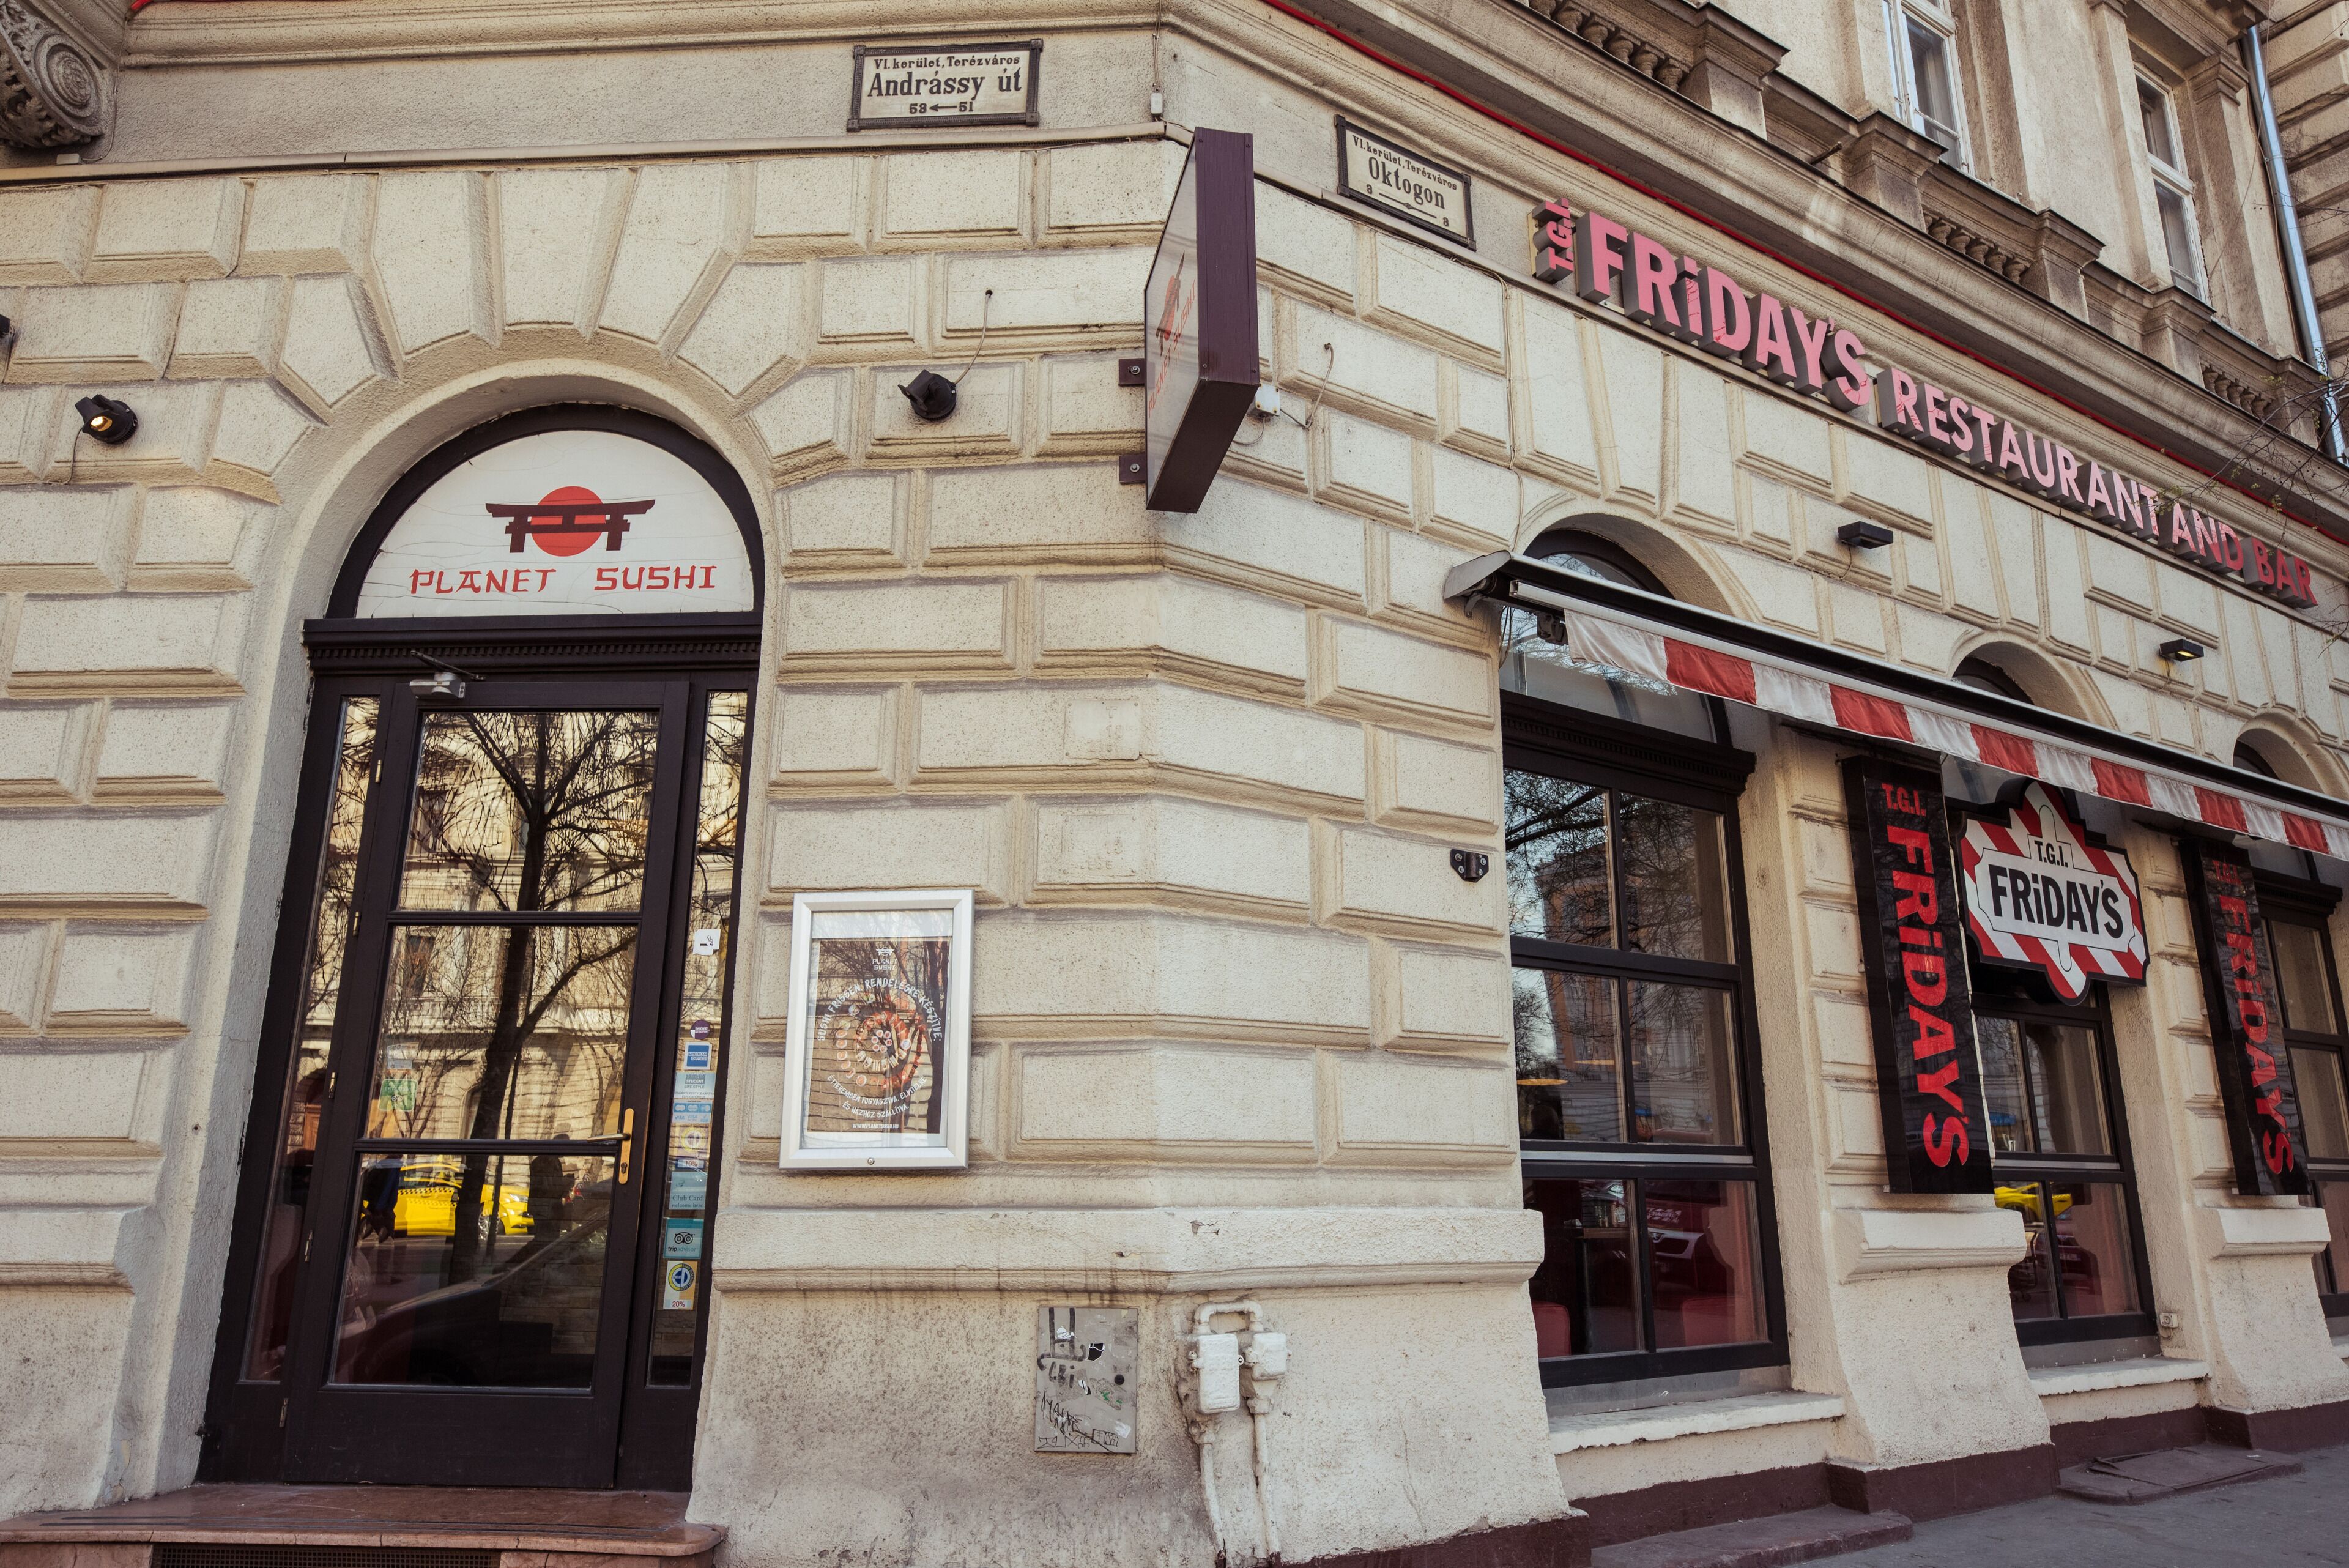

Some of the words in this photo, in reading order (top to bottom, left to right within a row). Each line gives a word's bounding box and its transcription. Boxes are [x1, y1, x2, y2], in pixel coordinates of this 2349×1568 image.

[892, 56, 945, 69] kerület,
[946, 54, 1020, 67] Terézváros
[867, 70, 985, 101] Andrássy
[998, 67, 1022, 92] út
[909, 102, 927, 114] 53
[959, 100, 974, 113] 51
[1368, 156, 1445, 210] Oktogon
[1405, 159, 1457, 190] Terézváros
[1173, 278, 1196, 352] SUSHI
[1541, 197, 1575, 275] T.G.I.
[1889, 368, 2159, 537] RESTAURANT
[2171, 500, 2244, 571] AND
[2250, 536, 2318, 606] BAR
[409, 568, 557, 595] PLANET
[594, 565, 718, 592] SUSHI
[1881, 783, 1927, 817] T.G.I.
[2034, 840, 2069, 868] T.G.I.
[817, 1013, 832, 1041] SUSHI
[827, 1074, 862, 1102] ÉTTEREMBEN
[900, 1076, 927, 1100] ELVITELRE
[842, 1101, 851, 1110] ÉS
[851, 1105, 877, 1118] HÁZHOZ
